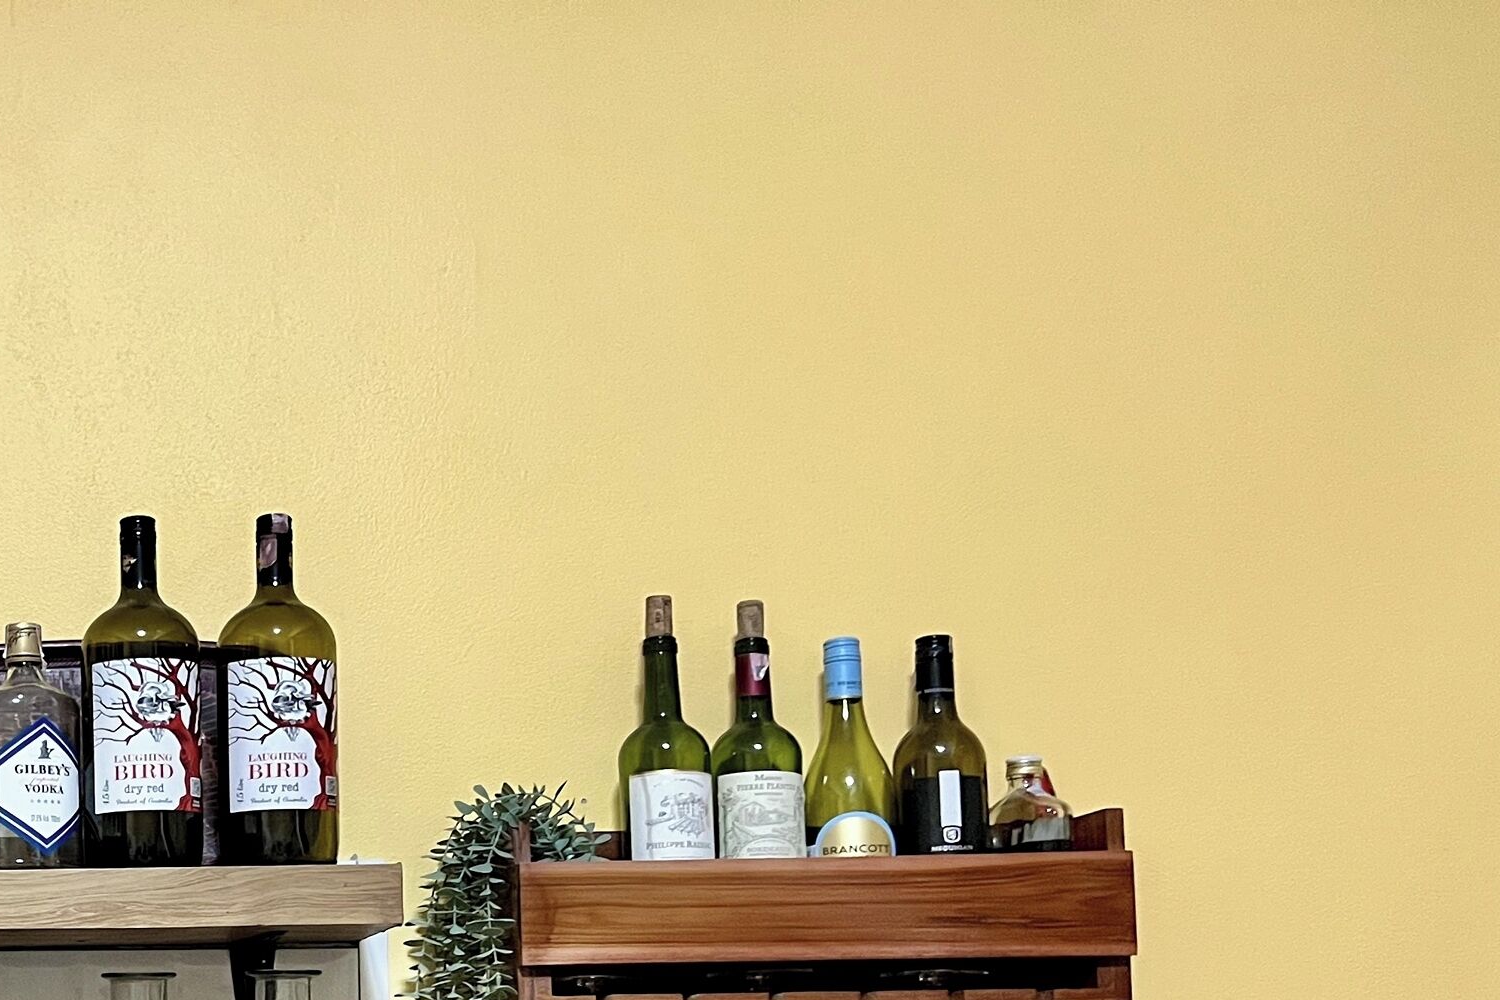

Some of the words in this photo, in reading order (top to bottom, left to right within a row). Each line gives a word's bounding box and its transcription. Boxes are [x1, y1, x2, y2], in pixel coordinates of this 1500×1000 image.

[114, 754, 173, 763] LAUGHING
[248, 752, 307, 762] LAUGHING
[14, 763, 71, 777] GILBEY'S
[115, 763, 174, 780] BIRD
[248, 762, 309, 780] BIRD
[25, 784, 64, 794] VODKA
[124, 784, 143, 795] dry
[147, 783, 165, 793] red
[258, 783, 278, 794] dry
[281, 782, 299, 792] red
[823, 844, 890, 856] BRANCOTT
